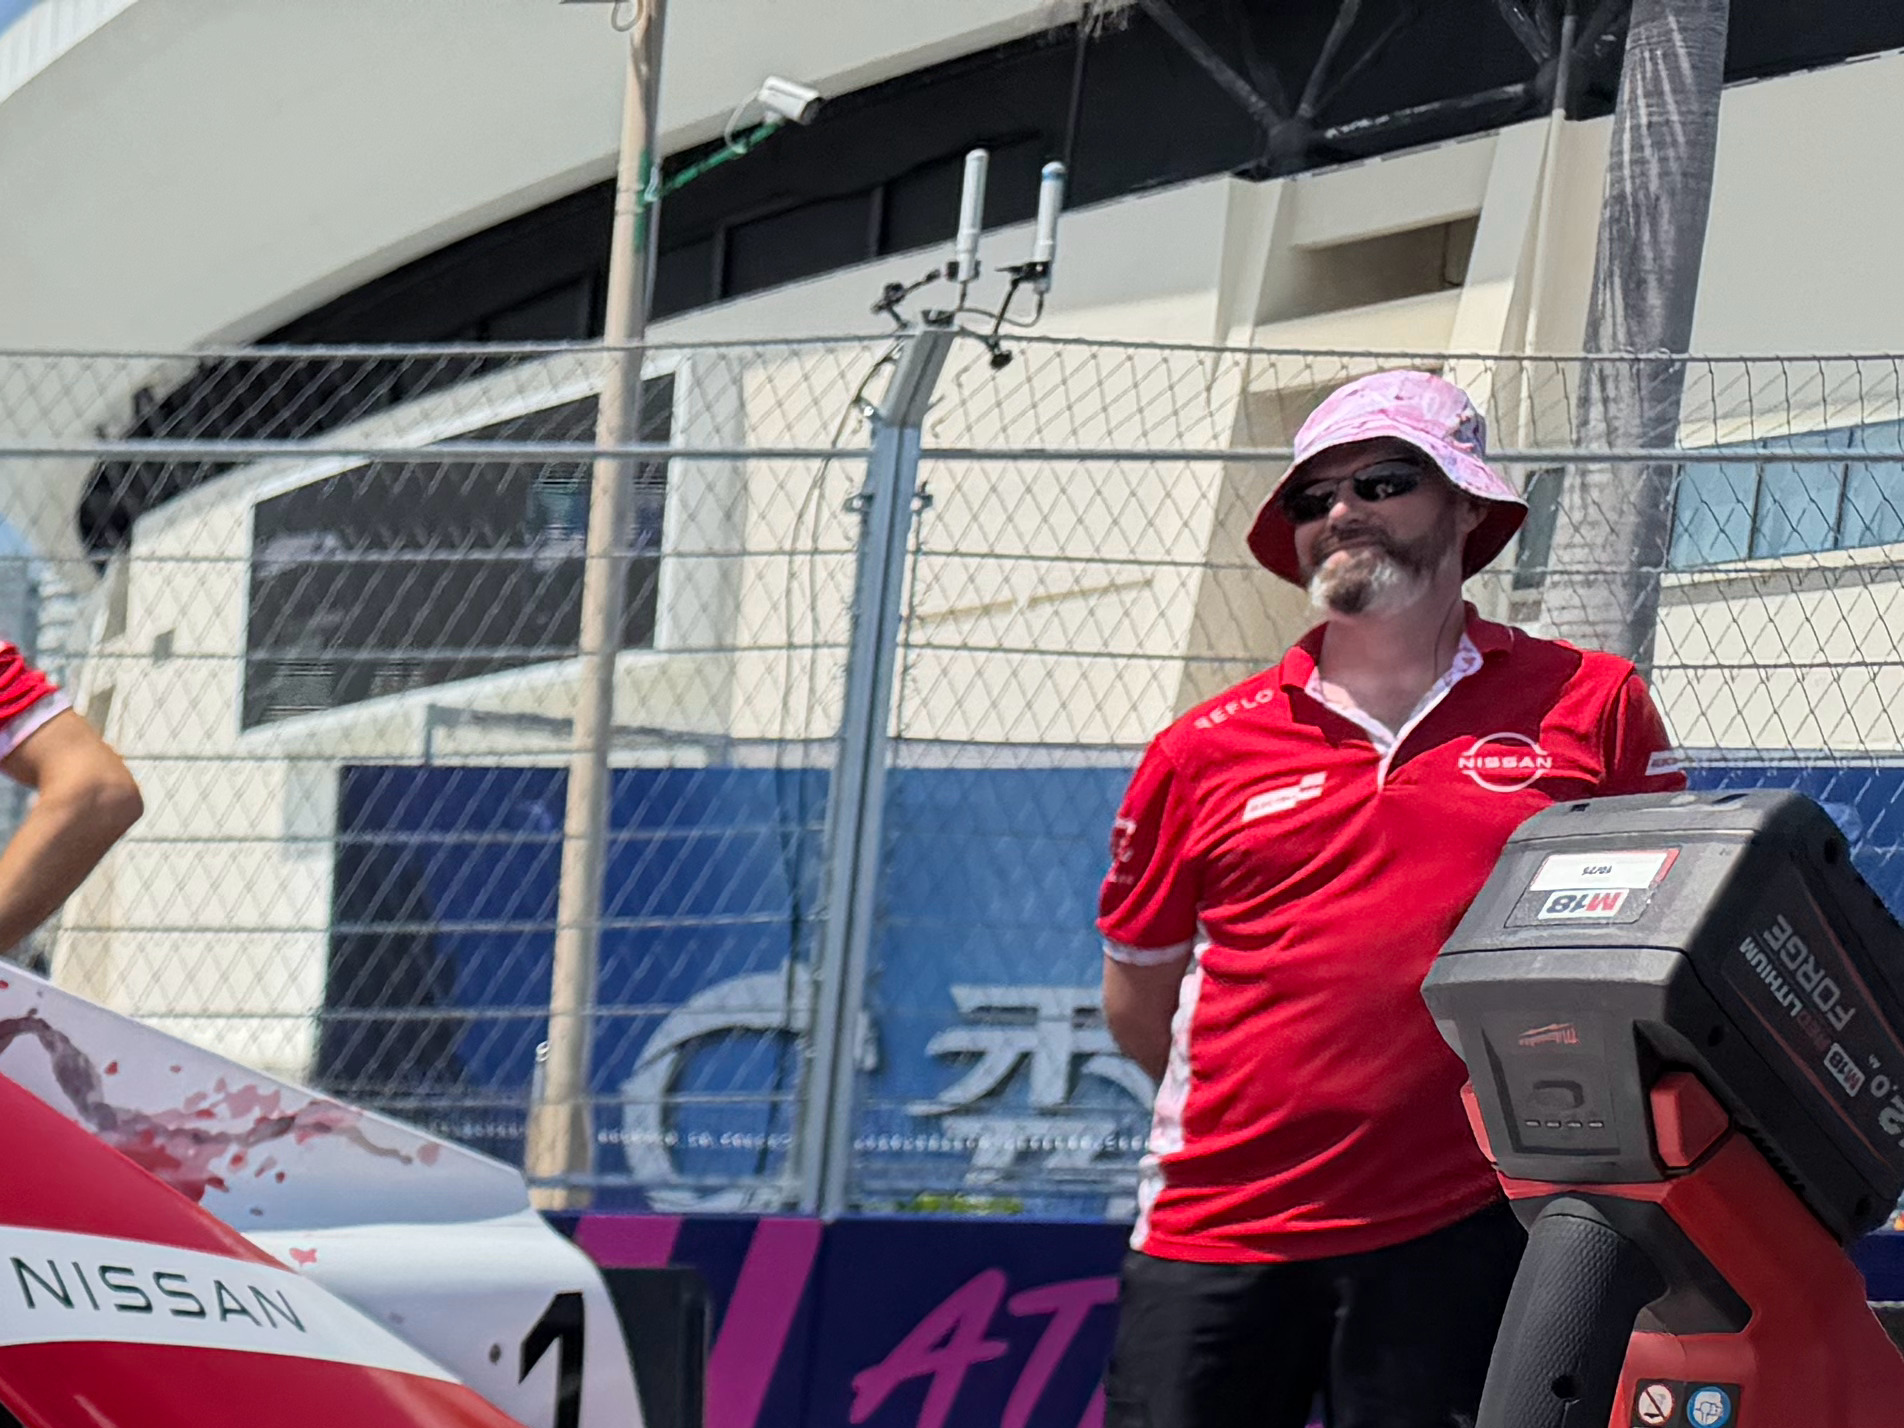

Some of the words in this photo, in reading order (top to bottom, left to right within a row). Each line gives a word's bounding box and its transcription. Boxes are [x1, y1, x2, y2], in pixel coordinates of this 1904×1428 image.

[1458, 755, 1552, 770] NISSAN
[1546, 891, 1623, 915] M18
[1763, 914, 1856, 1031] FORGE
[10, 1256, 307, 1334] NISSAN
